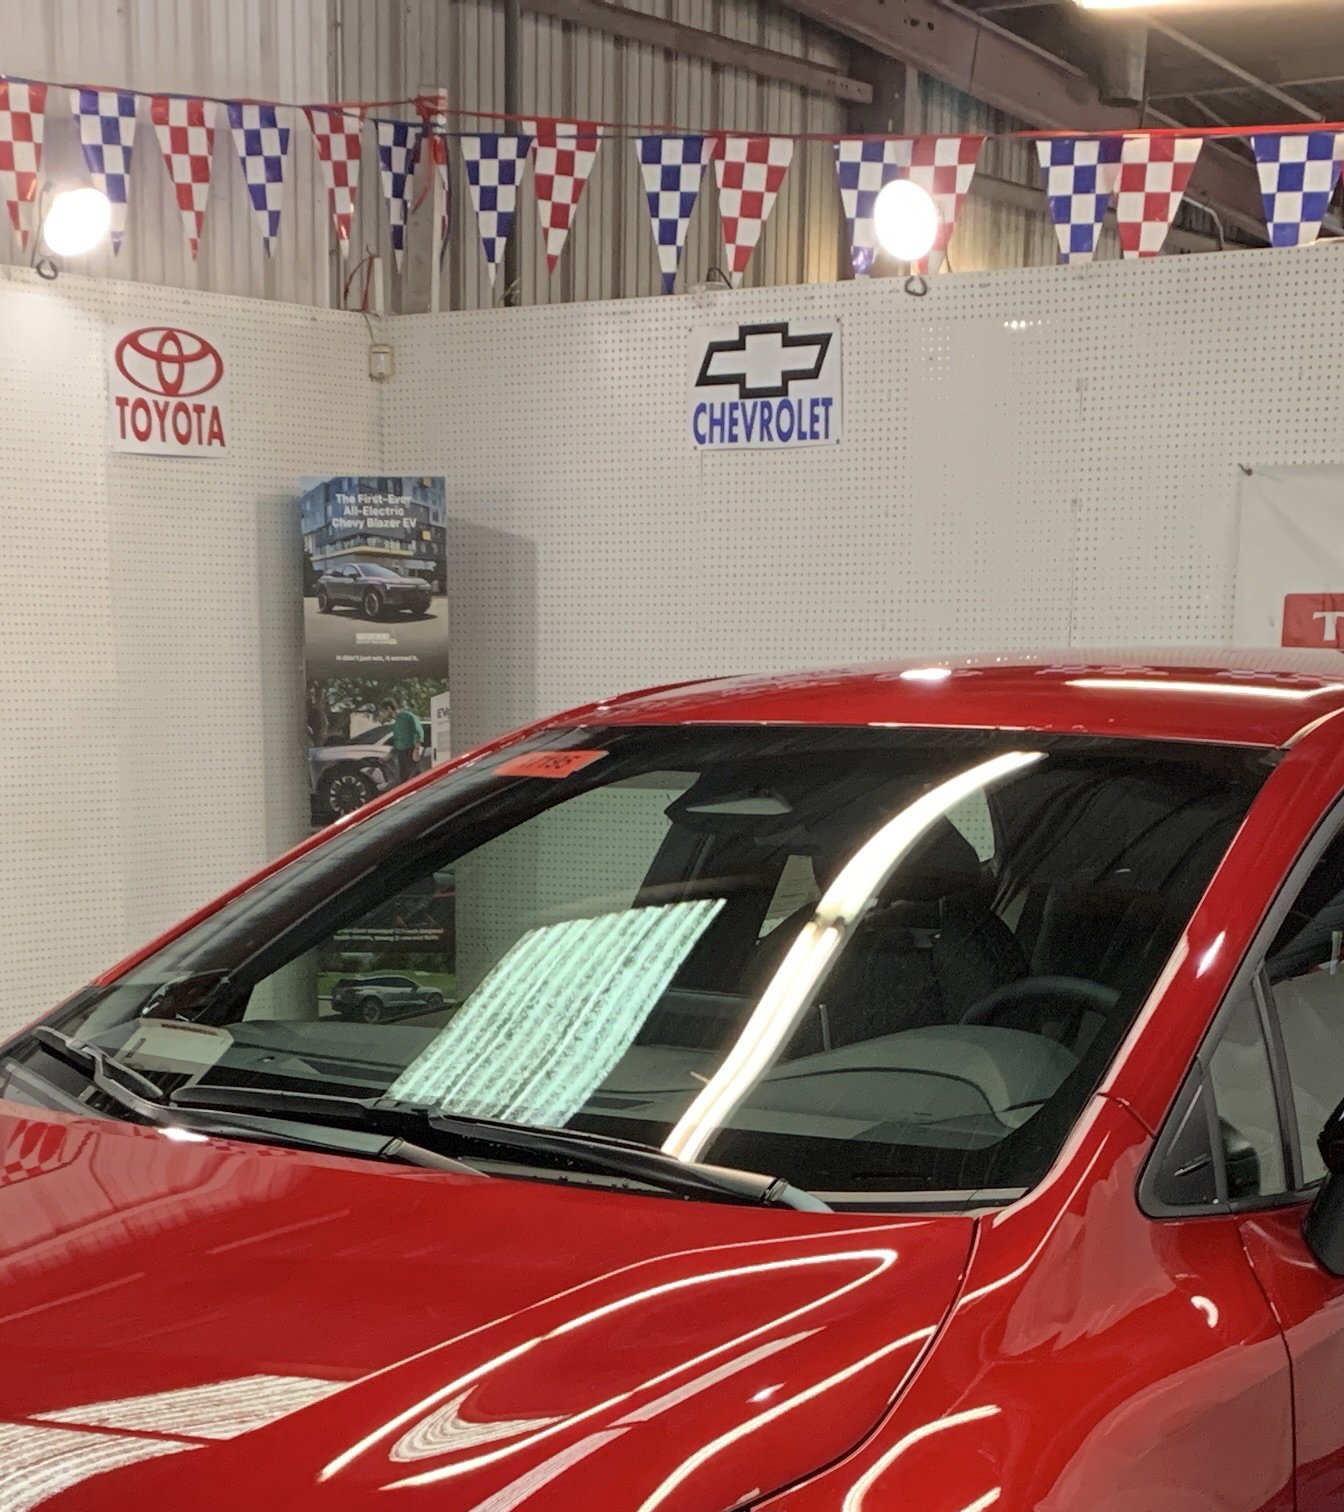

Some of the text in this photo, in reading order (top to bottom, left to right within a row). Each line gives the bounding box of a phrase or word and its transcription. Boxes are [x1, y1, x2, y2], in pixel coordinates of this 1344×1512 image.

[115, 396, 226, 448] TOYOTA
[692, 397, 833, 446] CHEVROLET
[336, 493, 412, 504] The First-Ever
[343, 505, 404, 517] All-Electric
[332, 517, 417, 529] Chevy Blazer EV
